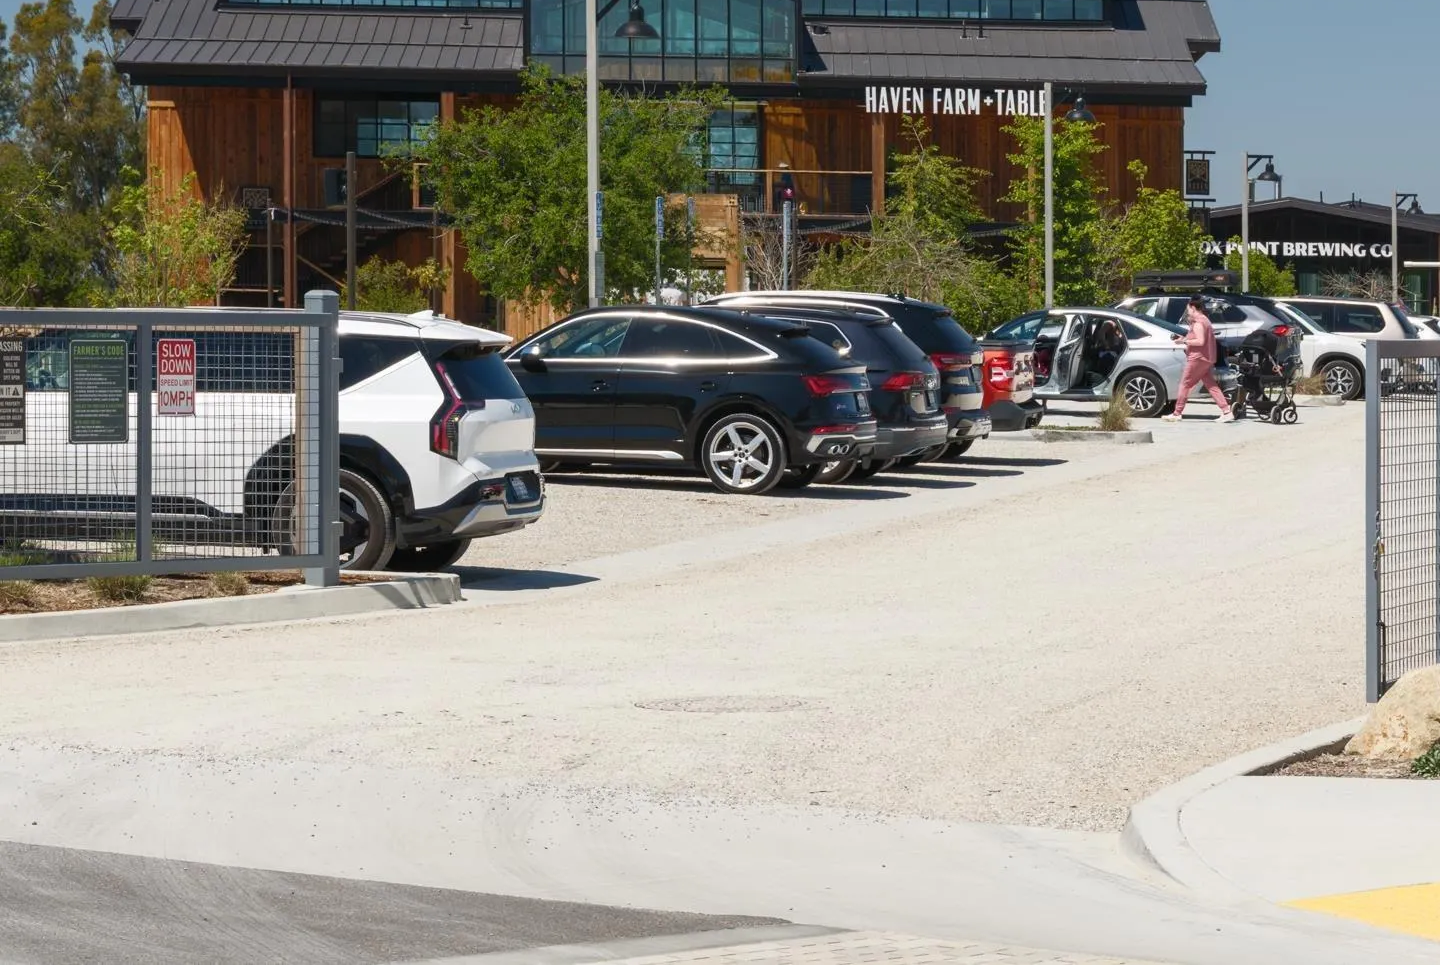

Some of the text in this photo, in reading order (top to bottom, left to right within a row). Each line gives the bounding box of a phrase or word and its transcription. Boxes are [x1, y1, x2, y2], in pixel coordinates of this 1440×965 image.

[865, 87, 924, 113] HAVEN
[1200, 240, 1223, 255] OX
[1283, 242, 1367, 257] BREWING
[74, 345, 124, 355] FARMER'S CODE
[162, 343, 191, 358] SLOW
[161, 359, 192, 373] DOWN
[160, 391, 193, 406] 10MPH
